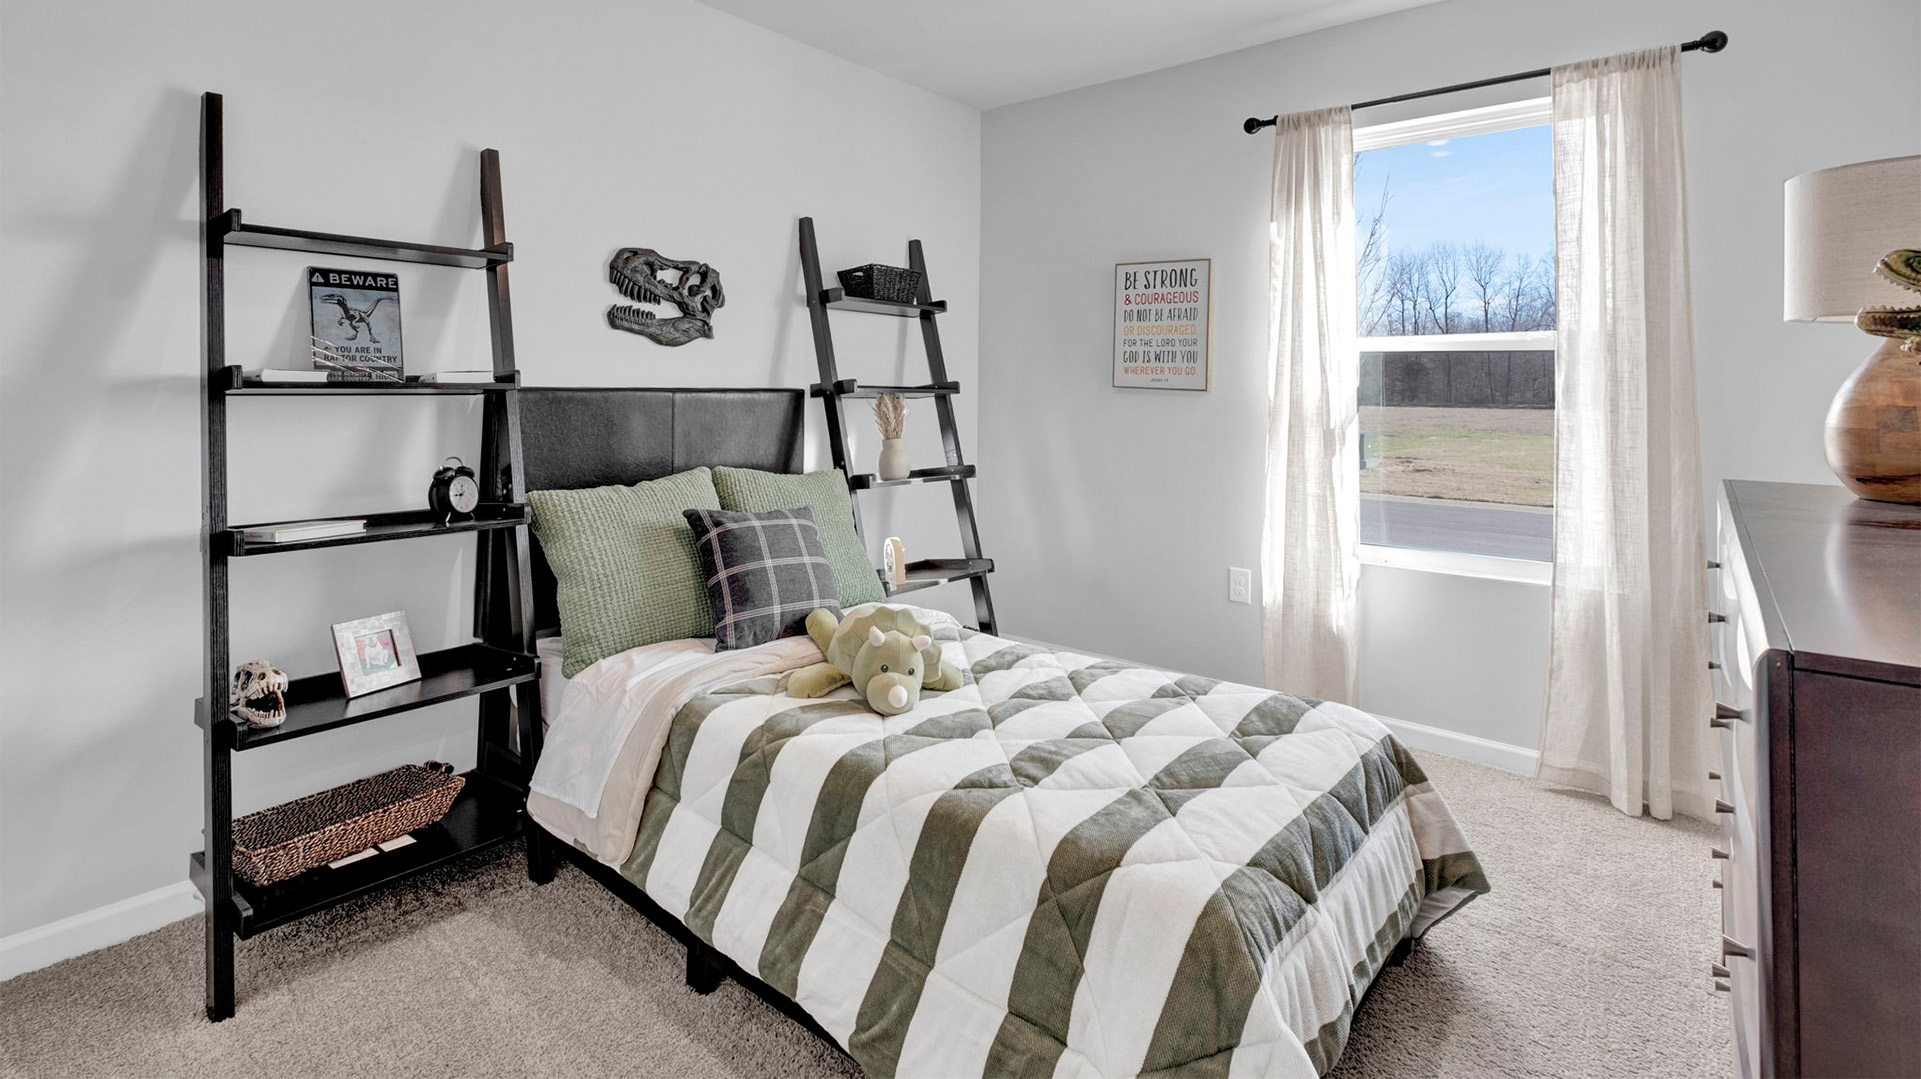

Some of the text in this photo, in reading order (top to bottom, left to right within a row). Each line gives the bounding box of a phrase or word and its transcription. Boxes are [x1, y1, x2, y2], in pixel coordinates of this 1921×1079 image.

[329, 273, 397, 288] BEWARE
[1124, 268, 1198, 290] BE STRONG
[1124, 291, 1199, 306] & COURAGEOUS
[1124, 308, 1198, 322] DO NOT BE AFRAID
[1124, 326, 1134, 336] OR
[1123, 338, 1198, 348] FOR THE LORD YOUR
[1123, 350, 1198, 364] GOD IS WITH YOU
[1124, 366, 1164, 376] WHEREVER
[1168, 366, 1183, 376] YOU
